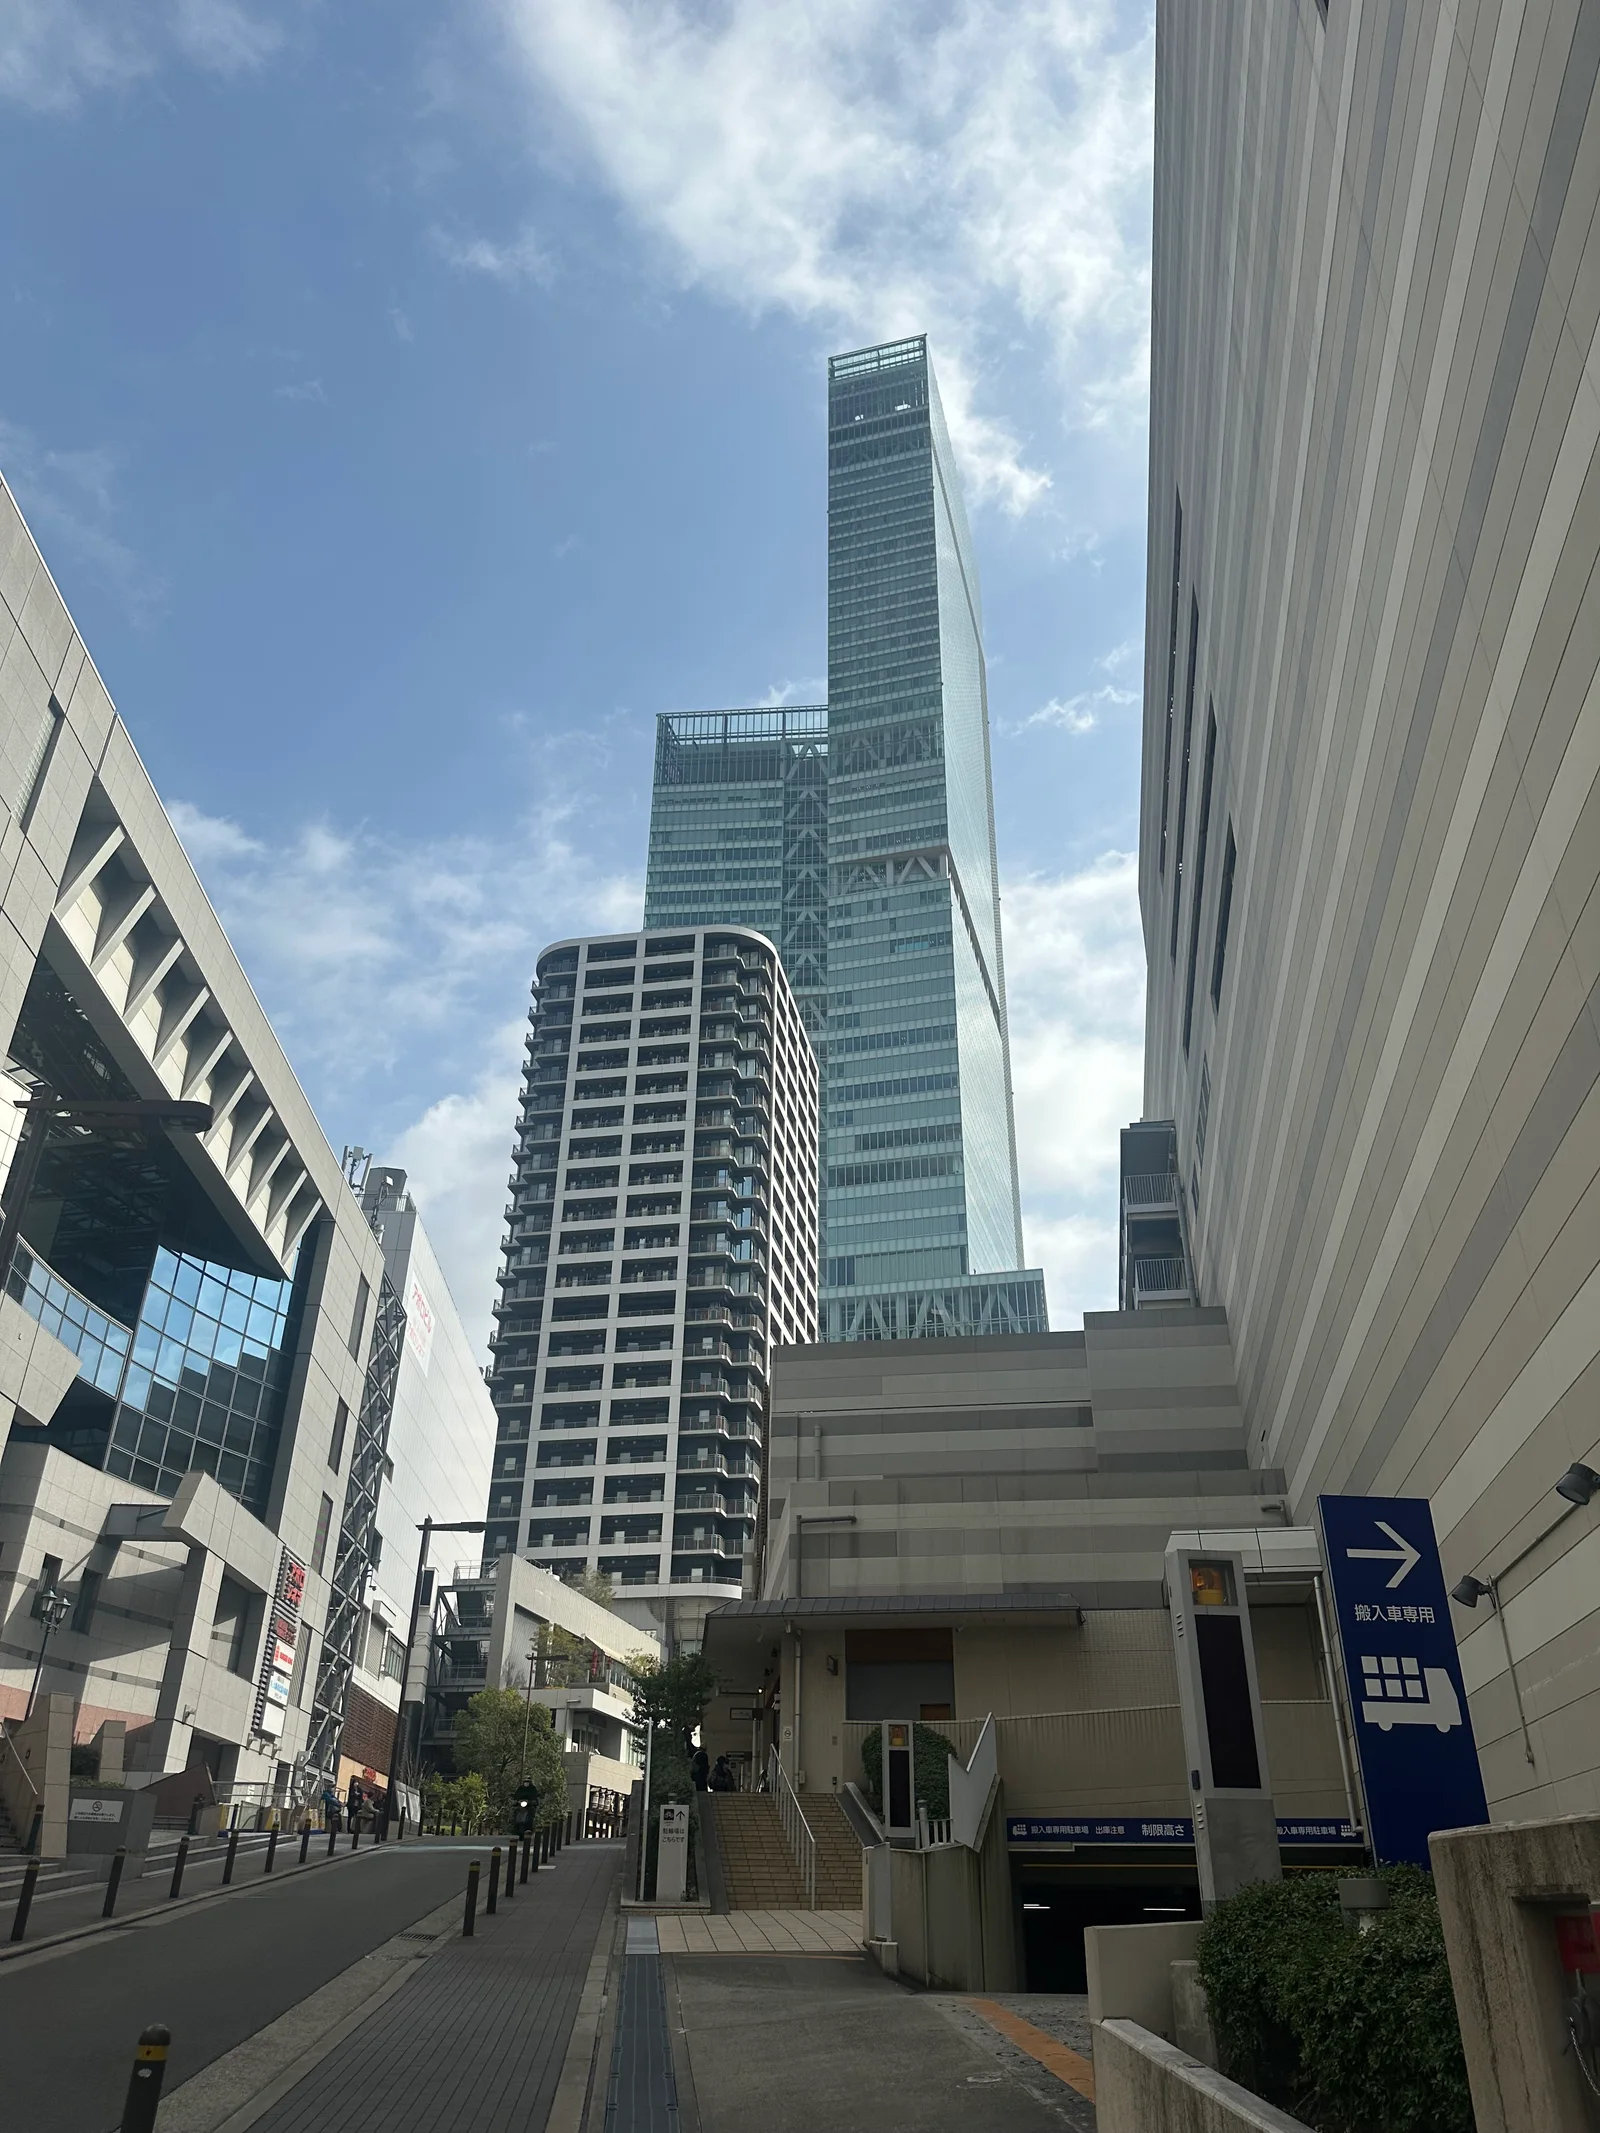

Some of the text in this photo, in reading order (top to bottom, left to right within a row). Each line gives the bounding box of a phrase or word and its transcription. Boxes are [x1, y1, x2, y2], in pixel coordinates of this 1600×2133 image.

[1354, 1603, 1436, 1624] 搬入車専用
[1031, 1825, 1089, 1835] 搬入車専用駐車場
[1095, 1825, 1126, 1835] 出庫注意
[1141, 1823, 1185, 1837] 制限高さ
